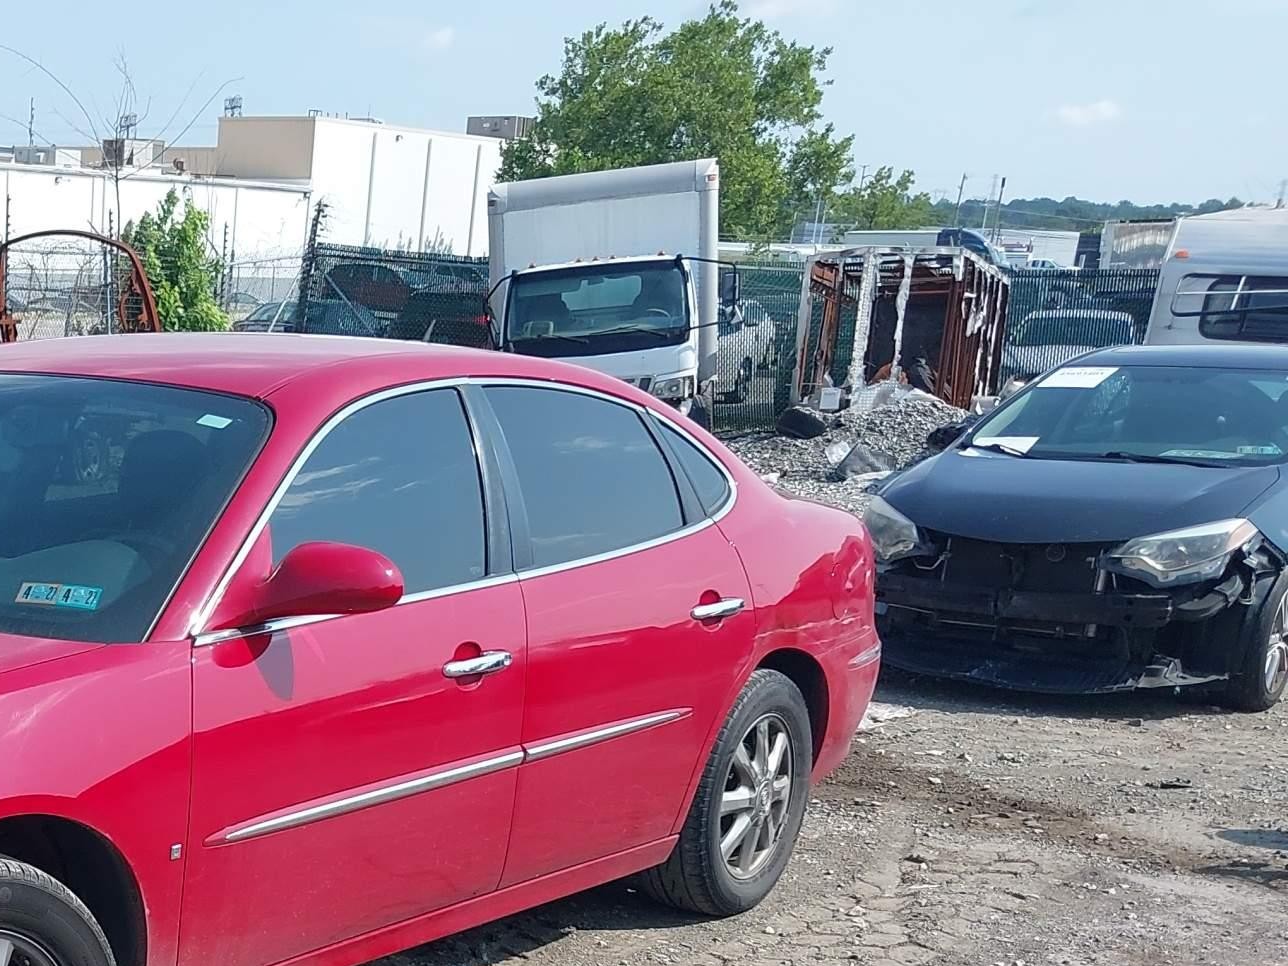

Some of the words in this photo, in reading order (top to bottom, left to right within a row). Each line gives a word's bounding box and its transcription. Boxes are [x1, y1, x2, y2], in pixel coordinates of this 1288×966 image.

[22, 585, 32, 600] 4
[45, 586, 58, 601] 27
[62, 588, 72, 603] 4
[85, 590, 98, 605] 27
